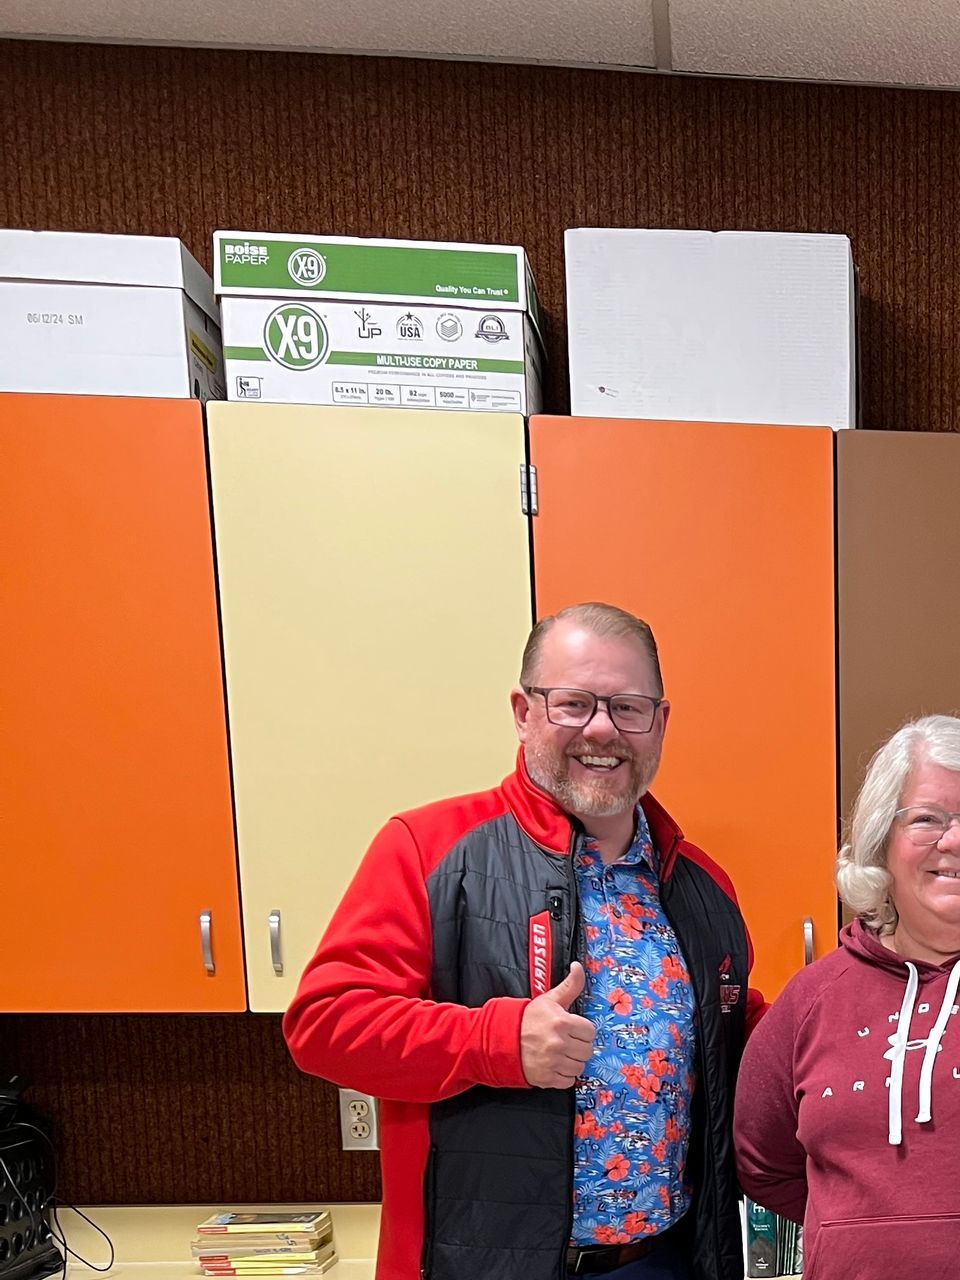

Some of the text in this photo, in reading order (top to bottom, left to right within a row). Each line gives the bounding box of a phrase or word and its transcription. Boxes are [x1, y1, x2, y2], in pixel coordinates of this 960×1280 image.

[225, 254, 269, 265] PAPER
[435, 284, 459, 295] Quality
[459, 286, 472, 294] You
[472, 287, 486, 295] Can
[67, 315, 83, 325] SM
[400, 326, 421, 338] USA
[376, 355, 478, 370] MULTI-USE COPY PAPER
